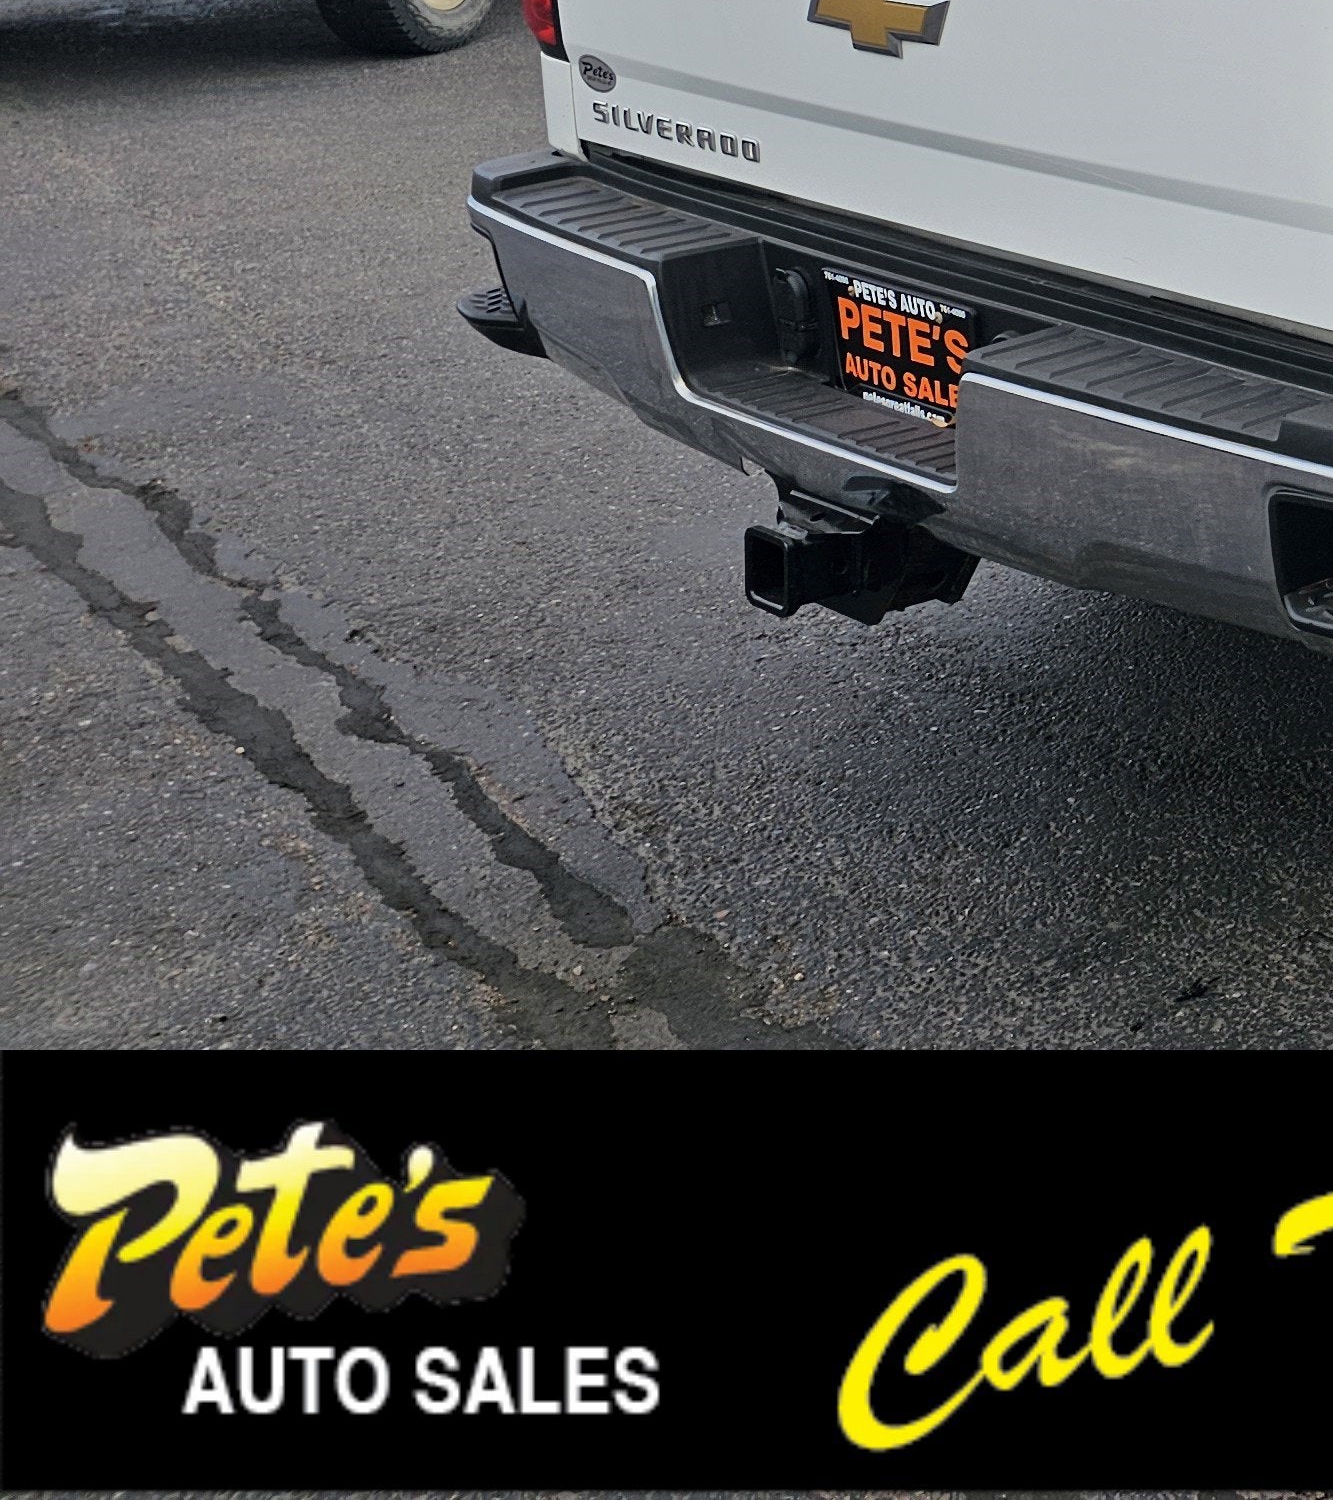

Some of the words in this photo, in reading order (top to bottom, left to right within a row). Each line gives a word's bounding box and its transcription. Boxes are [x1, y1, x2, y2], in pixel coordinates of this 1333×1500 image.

[592, 100, 761, 163] SILVERADO
[852, 279, 898, 310] PETE'S
[900, 293, 937, 321] AUTO
[837, 296, 969, 375] PETE'S
[845, 352, 897, 391] AUTO
[902, 372, 960, 409] SALE
